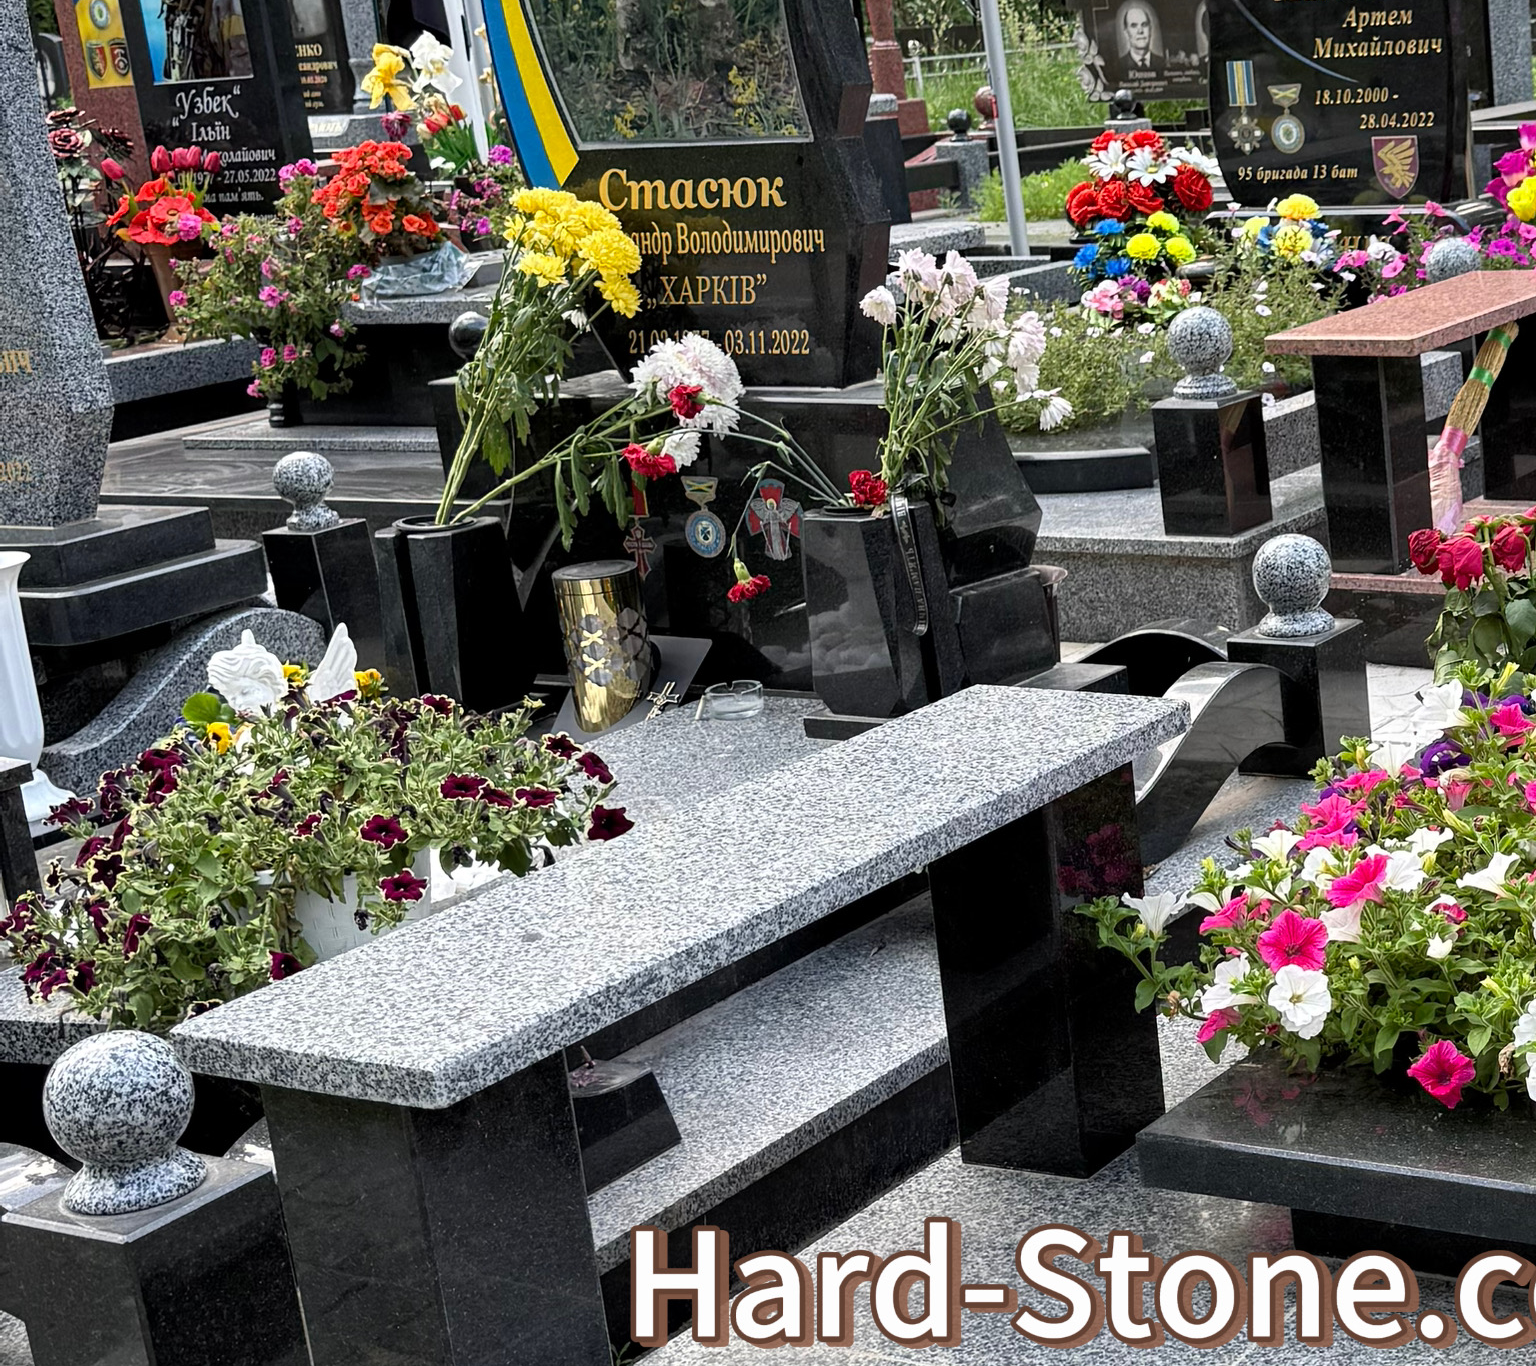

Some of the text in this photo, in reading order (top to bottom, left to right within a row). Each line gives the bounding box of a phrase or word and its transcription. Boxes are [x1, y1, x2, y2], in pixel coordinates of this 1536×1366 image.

[1341, 5, 1414, 34] Артем
[1312, 35, 1444, 60] Михайлович
[1314, 86, 1390, 106] 18.10.2000
[191, 121, 231, 142] Ільїн
[1358, 111, 1436, 131] 28.04.2022
[223, 168, 277, 184] 27.05.2022
[1237, 162, 1359, 184] 95 бригада 13 бат
[598, 168, 788, 212] Стасюк
[675, 220, 826, 265] Володимирович
[723, 328, 811, 356] 03.11.2022
